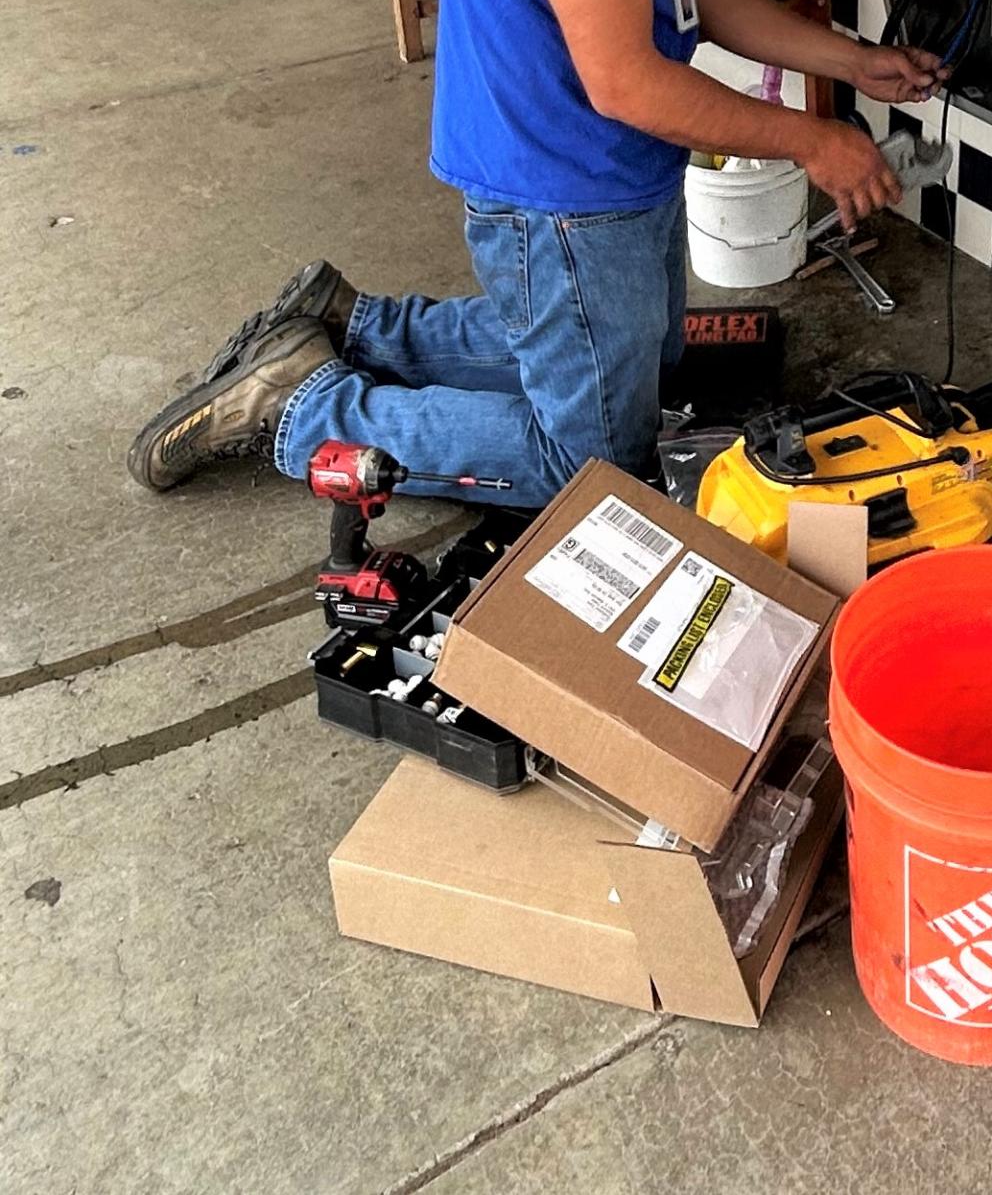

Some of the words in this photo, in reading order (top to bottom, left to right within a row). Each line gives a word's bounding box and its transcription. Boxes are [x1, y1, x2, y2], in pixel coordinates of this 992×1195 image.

[663, 641, 694, 681] PACKING
[685, 622, 707, 643] LIST
[697, 583, 729, 624] ENCLOSED
